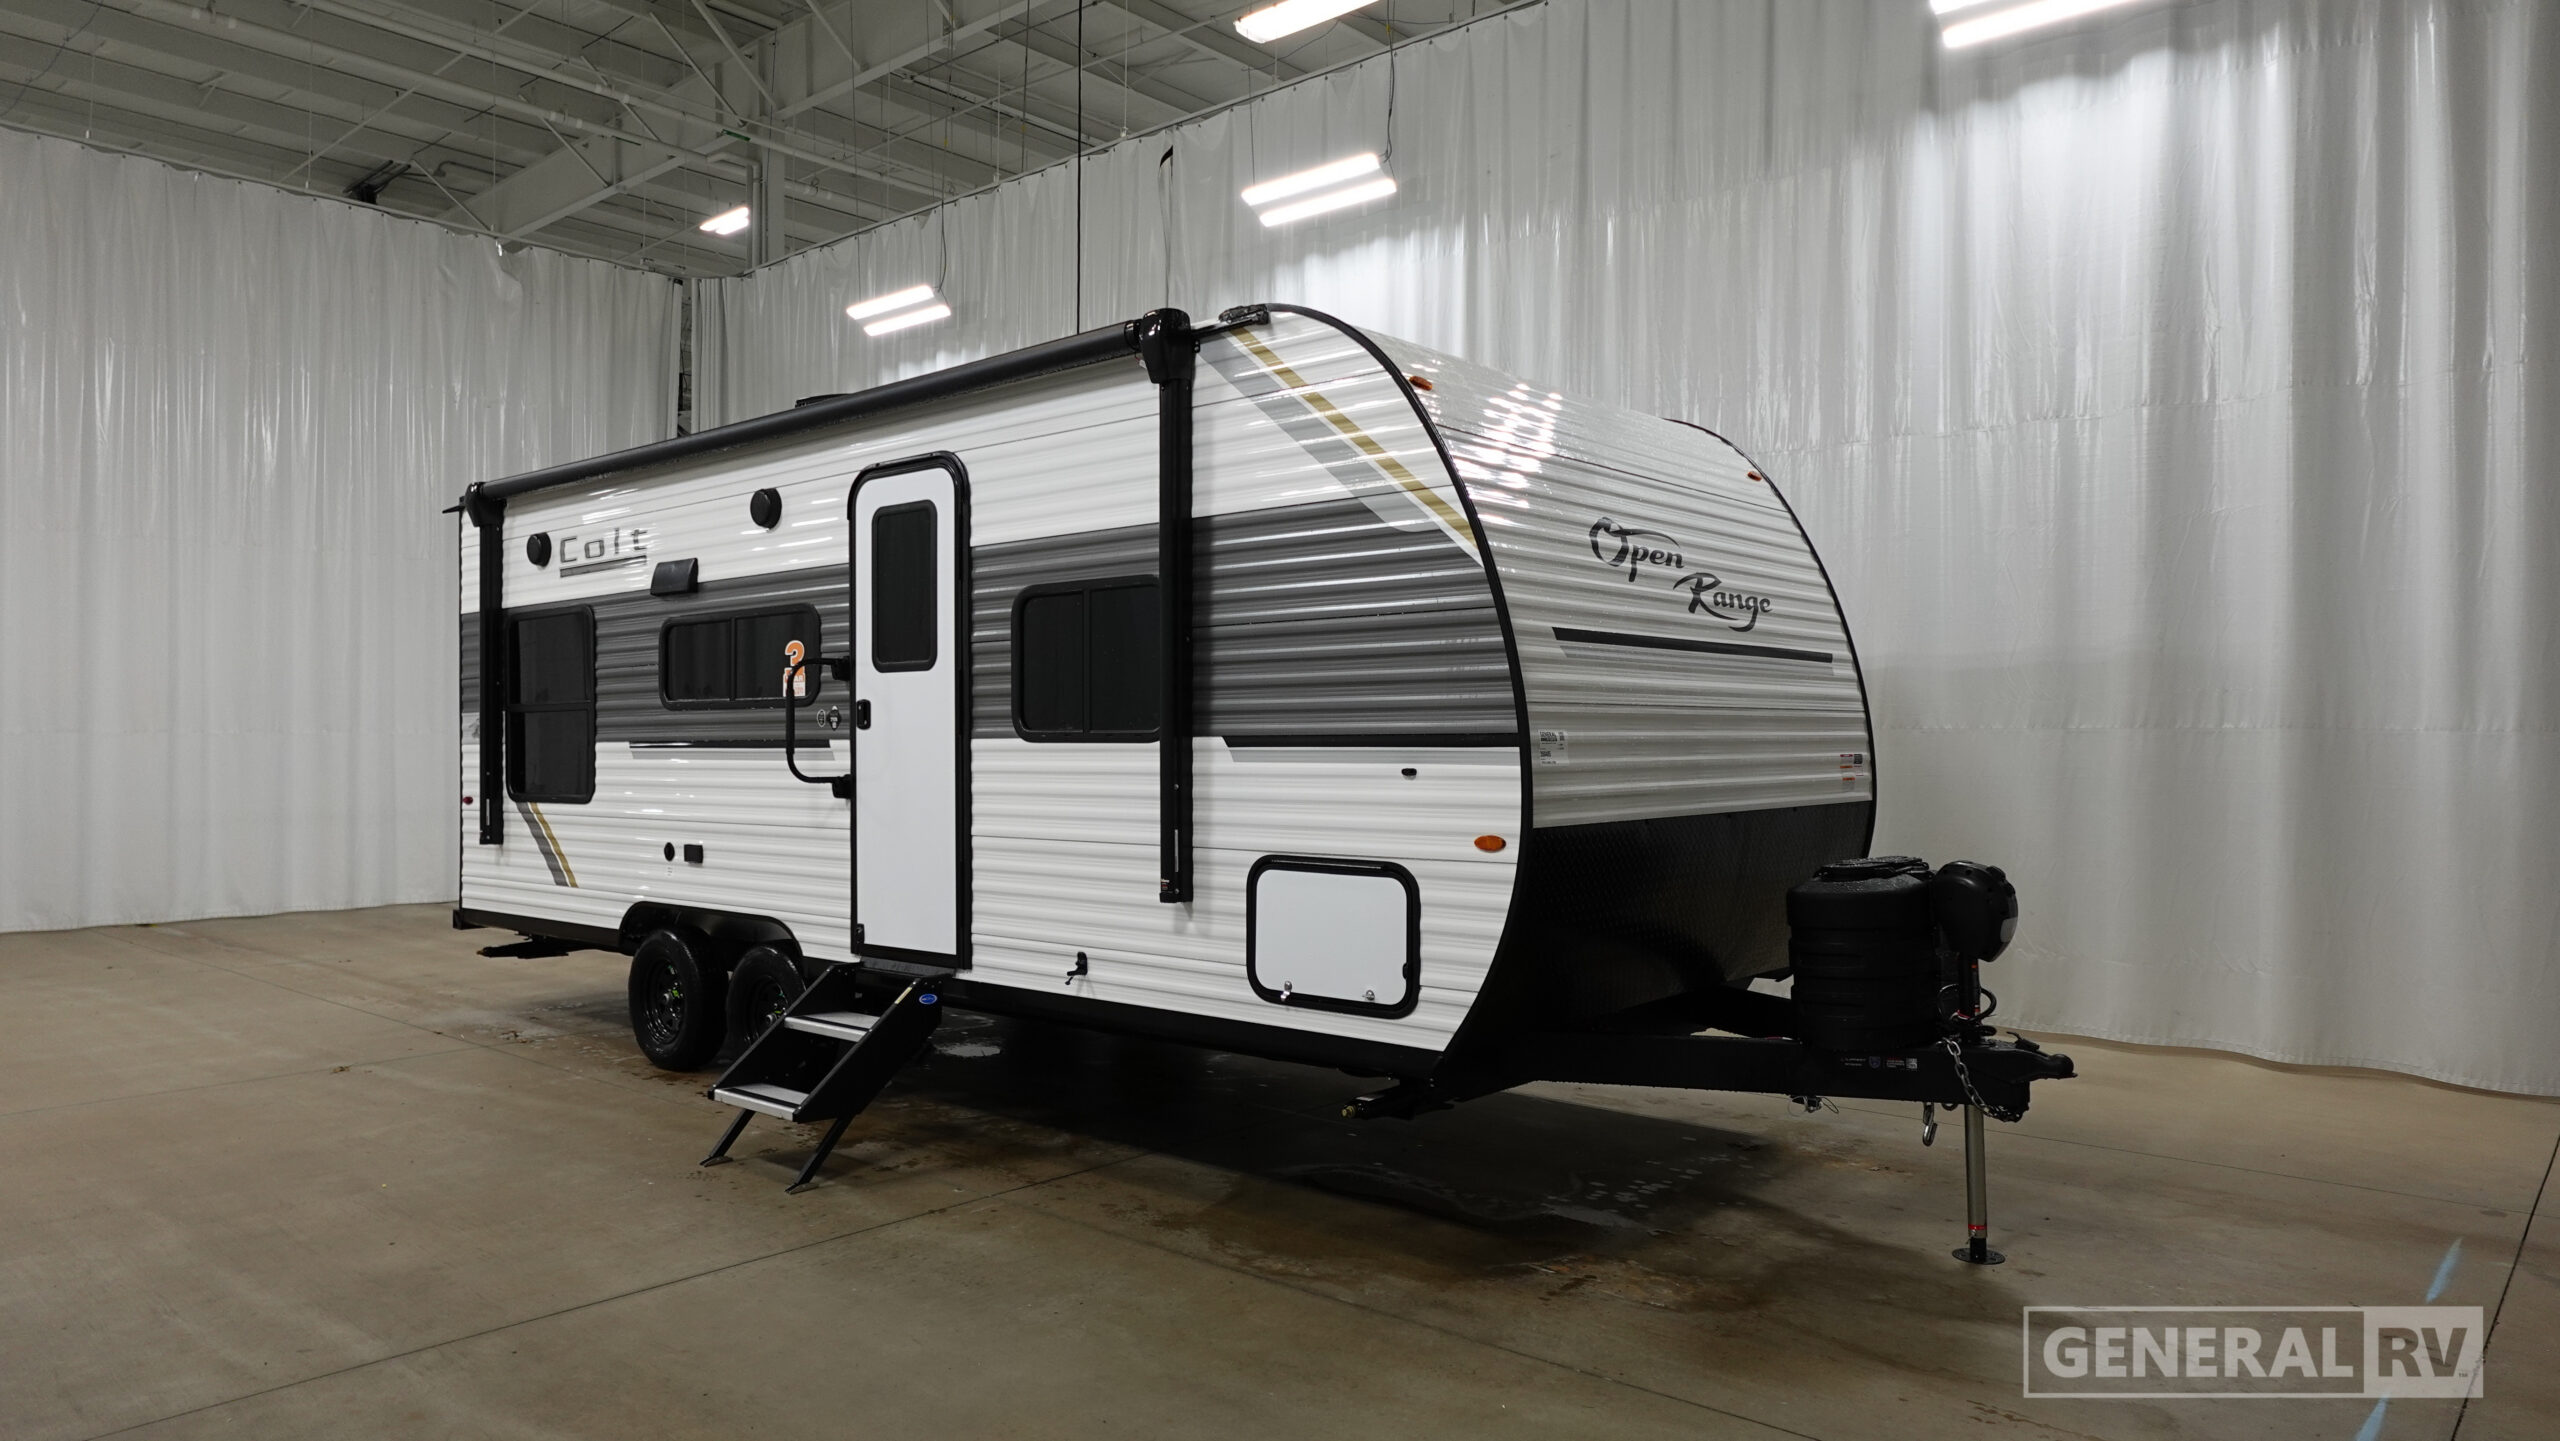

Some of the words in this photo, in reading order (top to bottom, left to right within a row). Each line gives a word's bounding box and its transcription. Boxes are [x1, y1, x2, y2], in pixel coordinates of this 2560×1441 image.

[560, 528, 648, 563] Colt
[1589, 517, 1684, 582] Open
[1673, 572, 1773, 632] Range
